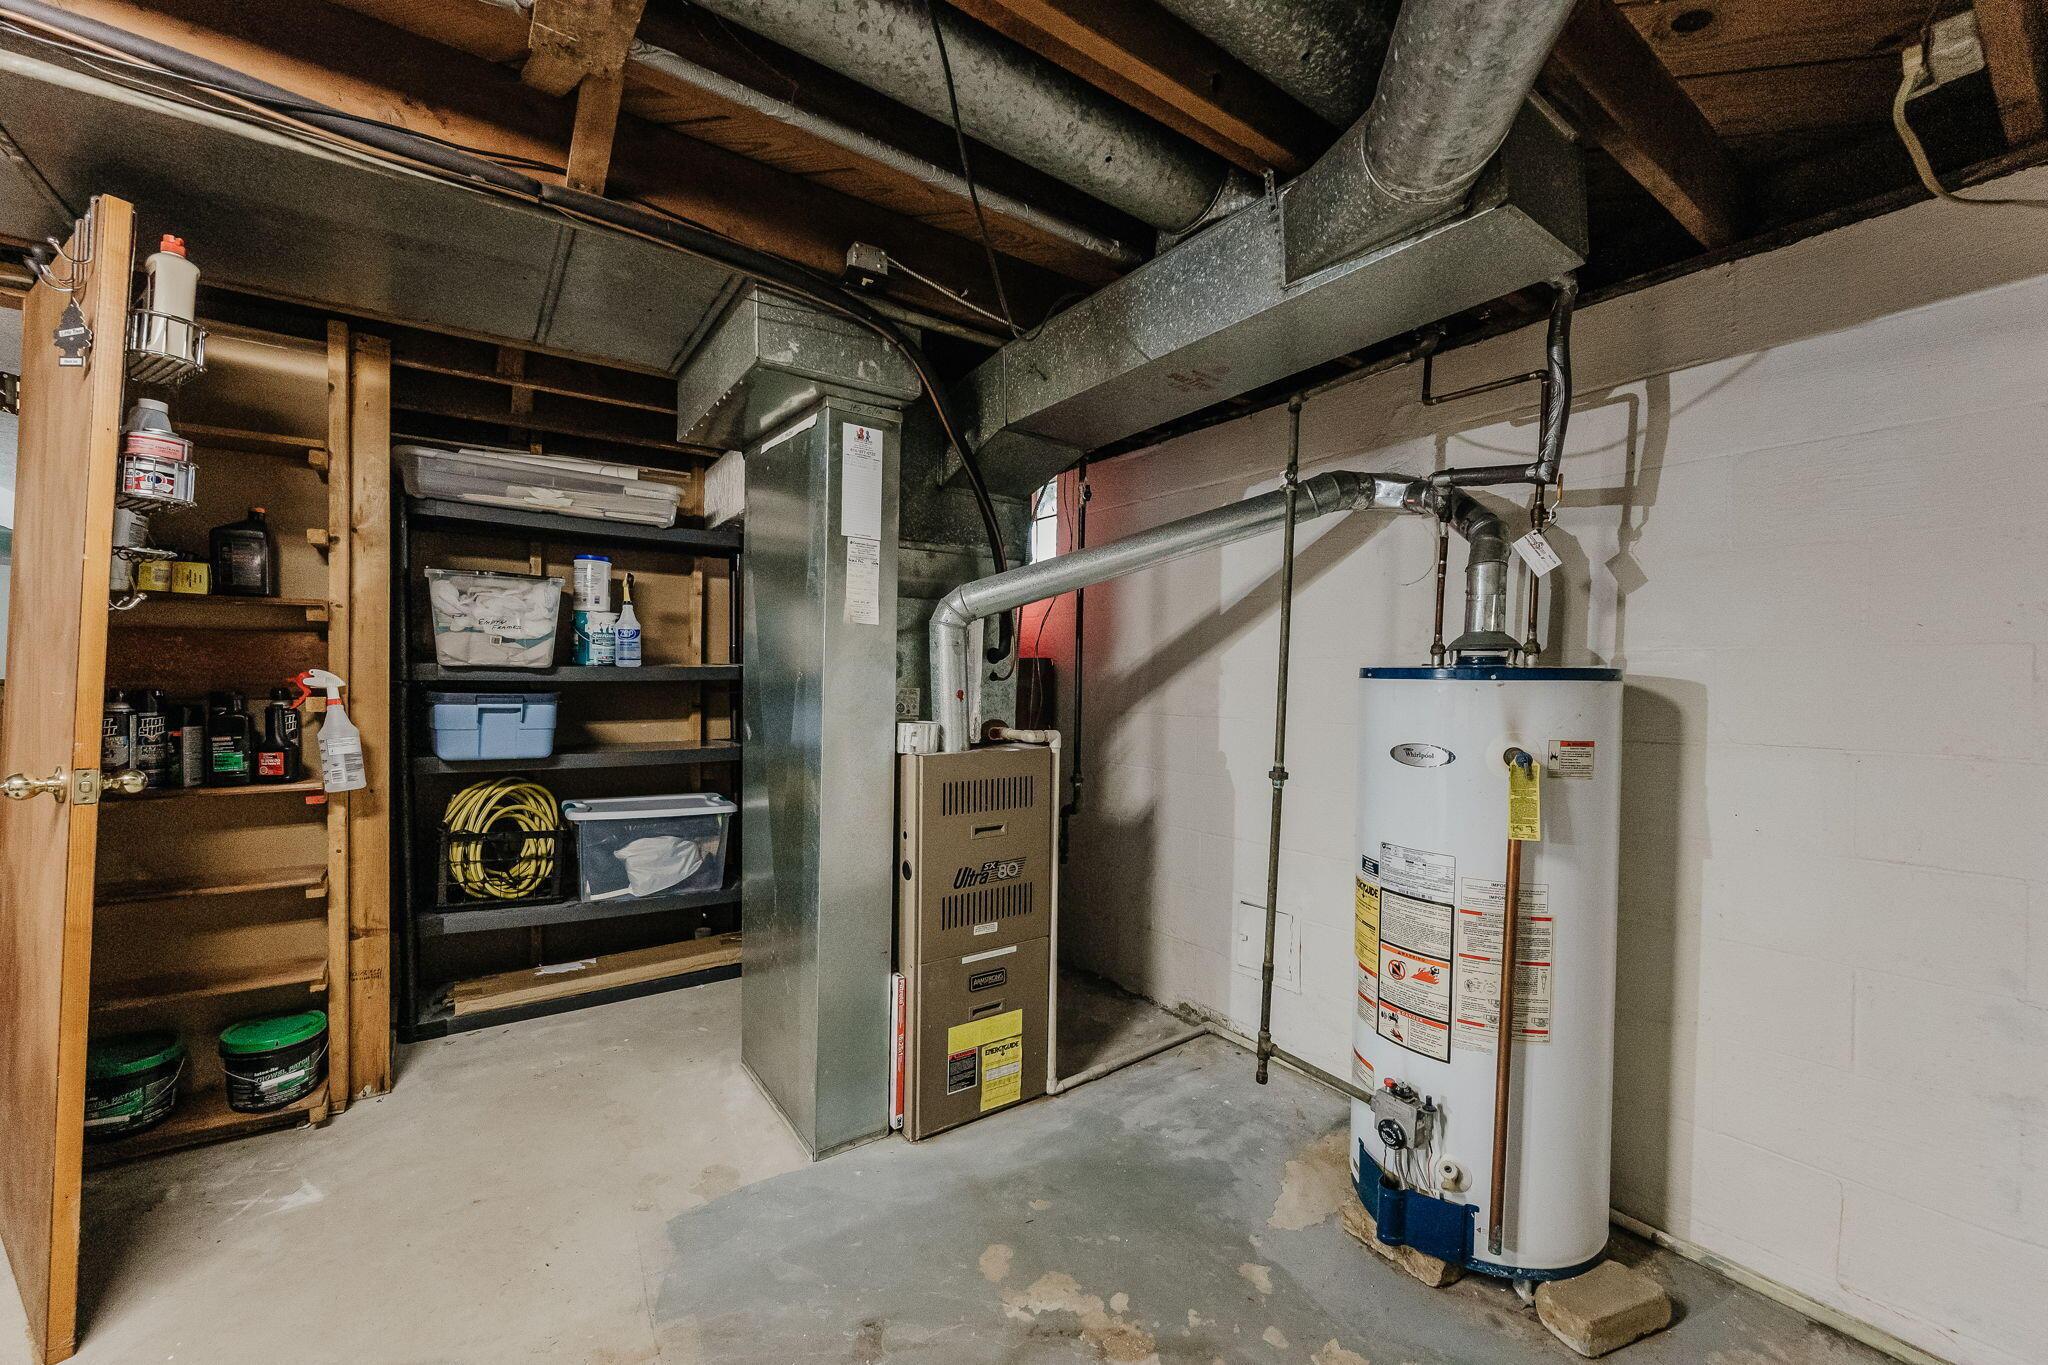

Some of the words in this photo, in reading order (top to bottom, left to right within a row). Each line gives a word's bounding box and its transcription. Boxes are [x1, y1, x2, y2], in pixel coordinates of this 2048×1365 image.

[1405, 751, 1435, 760] Whirlpool
[984, 862, 996, 871] SX
[954, 867, 990, 890] Ultra
[998, 862, 1019, 880] 80
